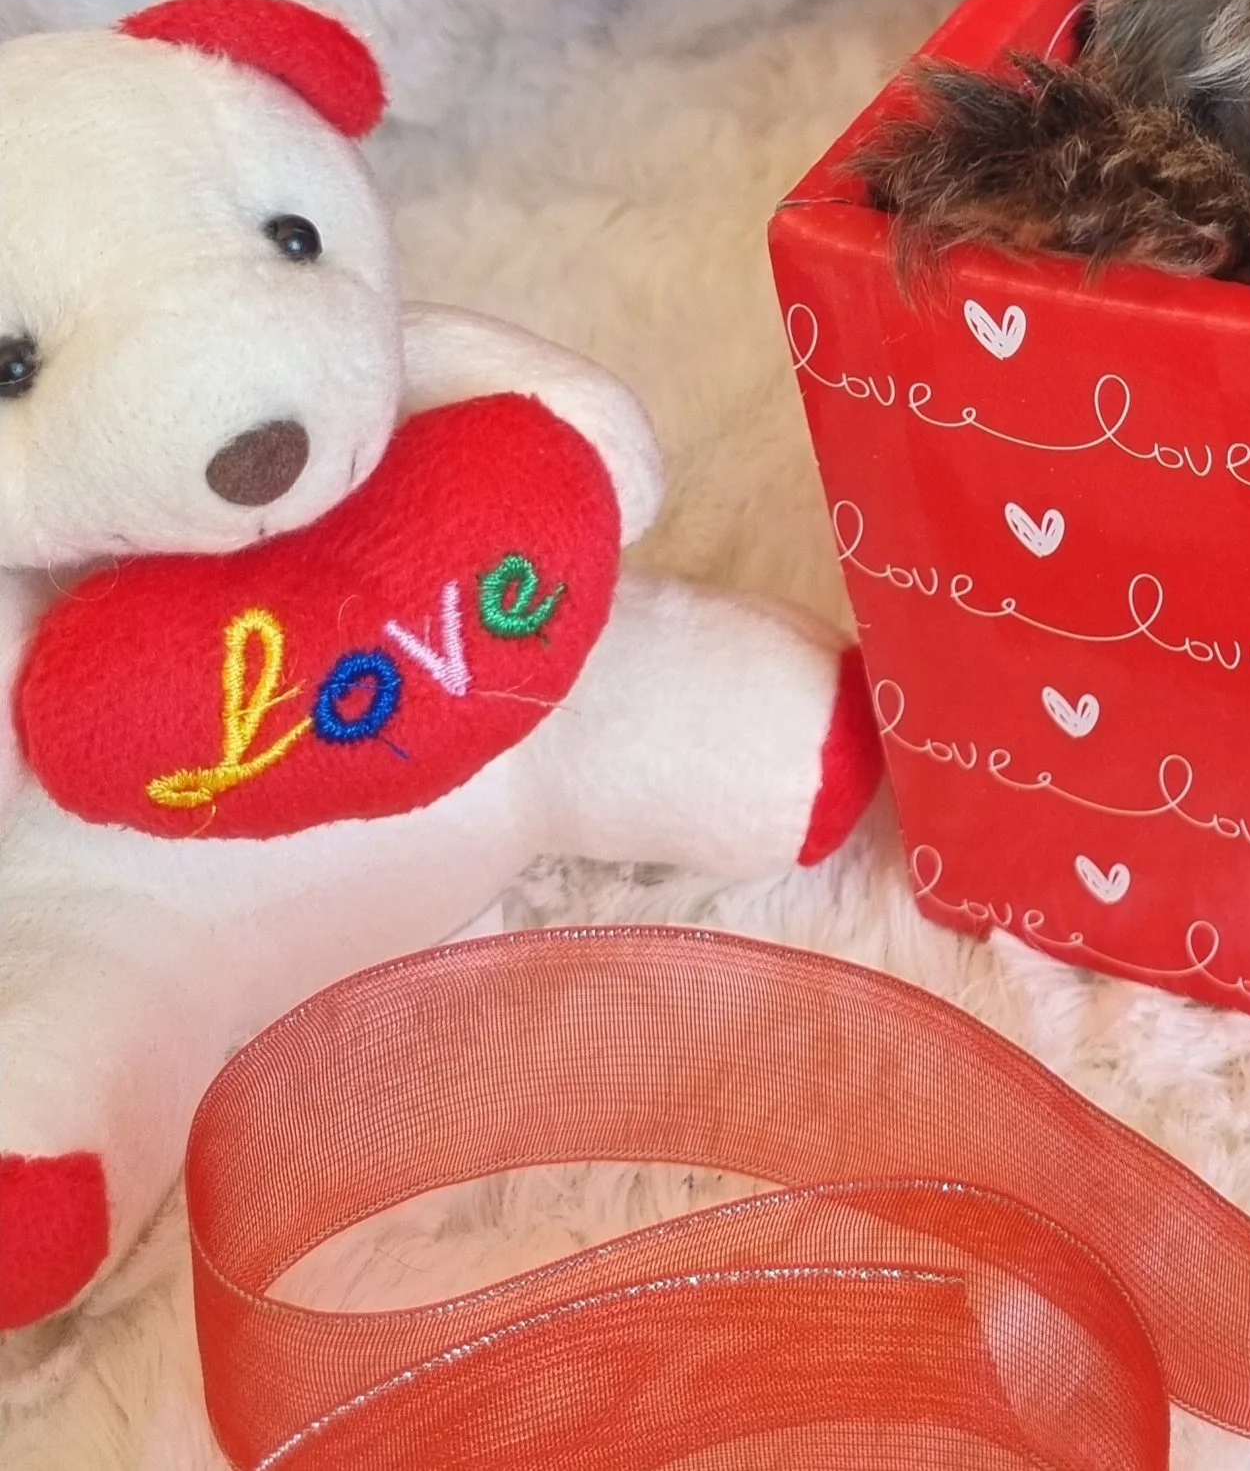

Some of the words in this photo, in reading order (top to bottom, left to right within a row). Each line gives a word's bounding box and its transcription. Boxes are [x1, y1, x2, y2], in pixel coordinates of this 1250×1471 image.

[787, 303, 969, 426] love
[833, 500, 1009, 617] love
[875, 680, 1045, 790] love
[911, 845, 1077, 946] love
